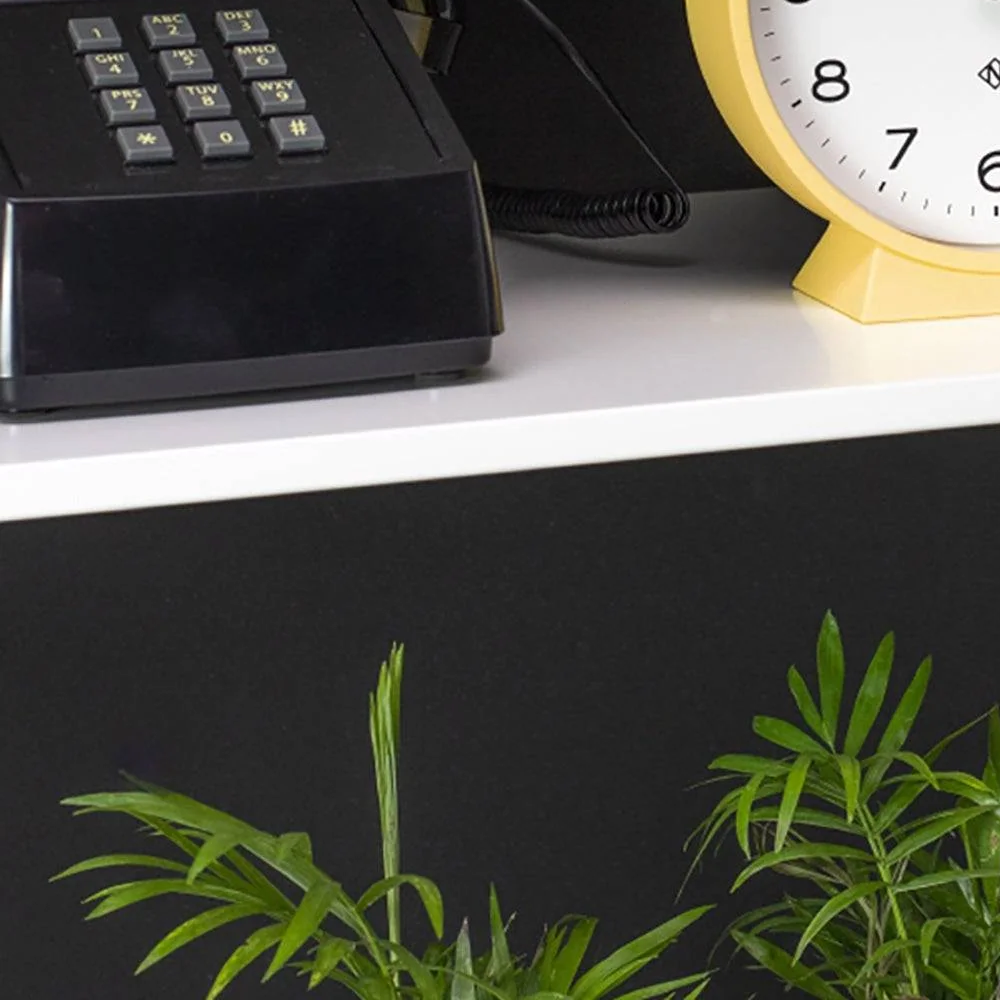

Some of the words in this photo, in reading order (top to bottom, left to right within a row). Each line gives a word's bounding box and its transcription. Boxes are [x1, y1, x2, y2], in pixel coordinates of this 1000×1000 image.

[152, 14, 183, 24] ABC
[168, 24, 179, 36] 2
[241, 20, 252, 33] 3
[92, 28, 101, 39] 1
[237, 44, 277, 55] MNO
[95, 54, 124, 64] GHI
[256, 54, 269, 67] 6
[109, 63, 122, 75] 4
[258, 81, 294, 92] WXY
[811, 59, 850, 103] 8
[111, 89, 143, 100] PRS
[185, 85, 219, 96] TUV
[275, 90, 289, 103] 9
[126, 98, 138, 111] 7
[201, 94, 215, 107] 8
[886, 127, 918, 170] 7
